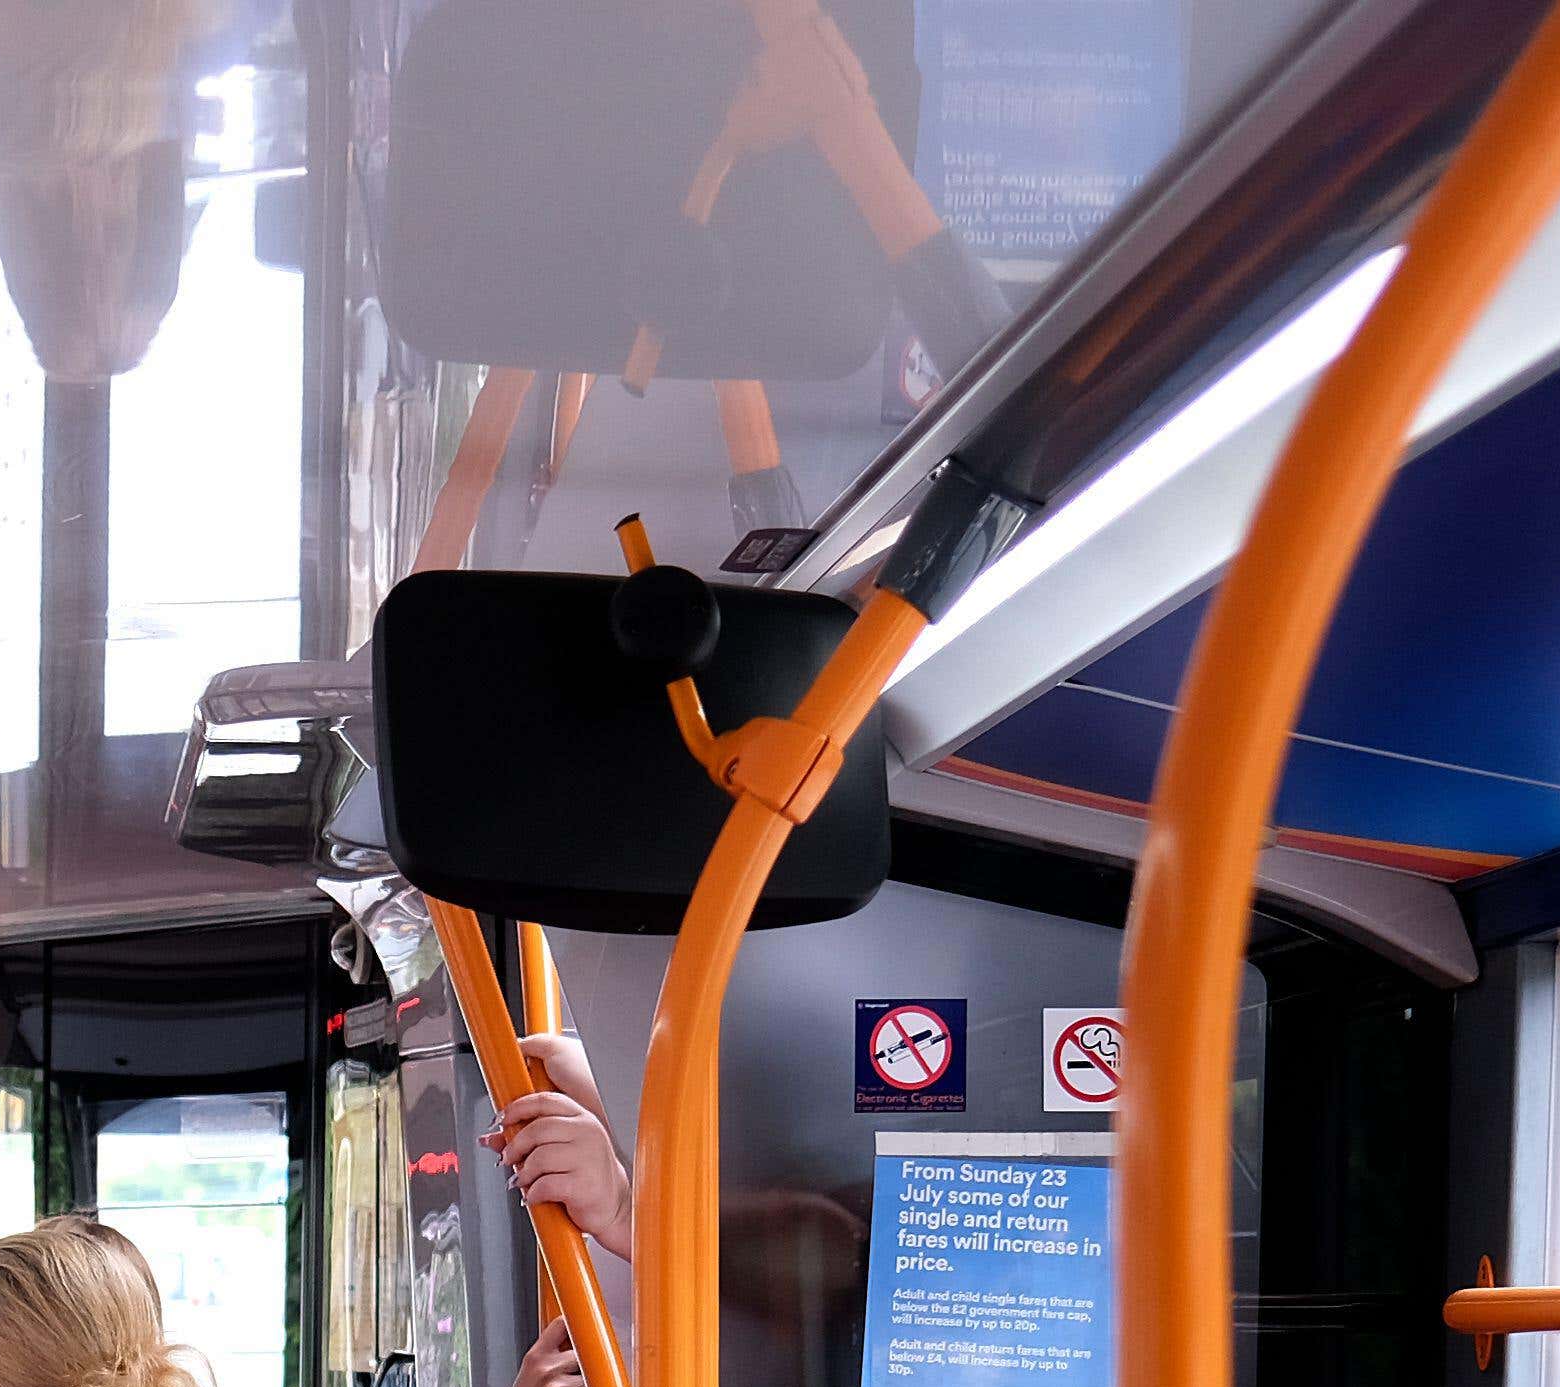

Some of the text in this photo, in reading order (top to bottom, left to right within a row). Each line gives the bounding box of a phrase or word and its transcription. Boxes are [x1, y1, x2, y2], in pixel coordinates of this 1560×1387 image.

[856, 1093, 964, 1105] Electronic Cigarettes
[902, 1161, 1067, 1188] From Sunday 23
[900, 1184, 1068, 1209] July some of our
[899, 1206, 1068, 1232] single and return
[897, 1229, 1101, 1256] fares will increase in
[896, 1252, 954, 1273] price.
[893, 1288, 925, 1300] Adult
[928, 1292, 949, 1301] and
[952, 1291, 980, 1303] child
[983, 1293, 1016, 1306] single
[1050, 1297, 1072, 1307] that
[892, 1301, 928, 1313] below
[931, 1303, 949, 1314] the
[969, 1306, 1039, 1319] government
[1067, 1312, 1092, 1323] cap,
[891, 1314, 1040, 1333] will increase by up to 20p.
[889, 1339, 921, 1349] Adult
[924, 1340, 945, 1351] and
[948, 1341, 976, 1353] child
[979, 1344, 1014, 1354] return
[1047, 1346, 1070, 1358] that
[888, 1364, 914, 1376] 30p.
[889, 1351, 925, 1363] below
[948, 1354, 968, 1365] will
[971, 1356, 1019, 1368] increase
[1021, 1357, 1035, 1371] by
[1038, 1360, 1054, 1371] up
[1056, 1360, 1067, 1370] to
